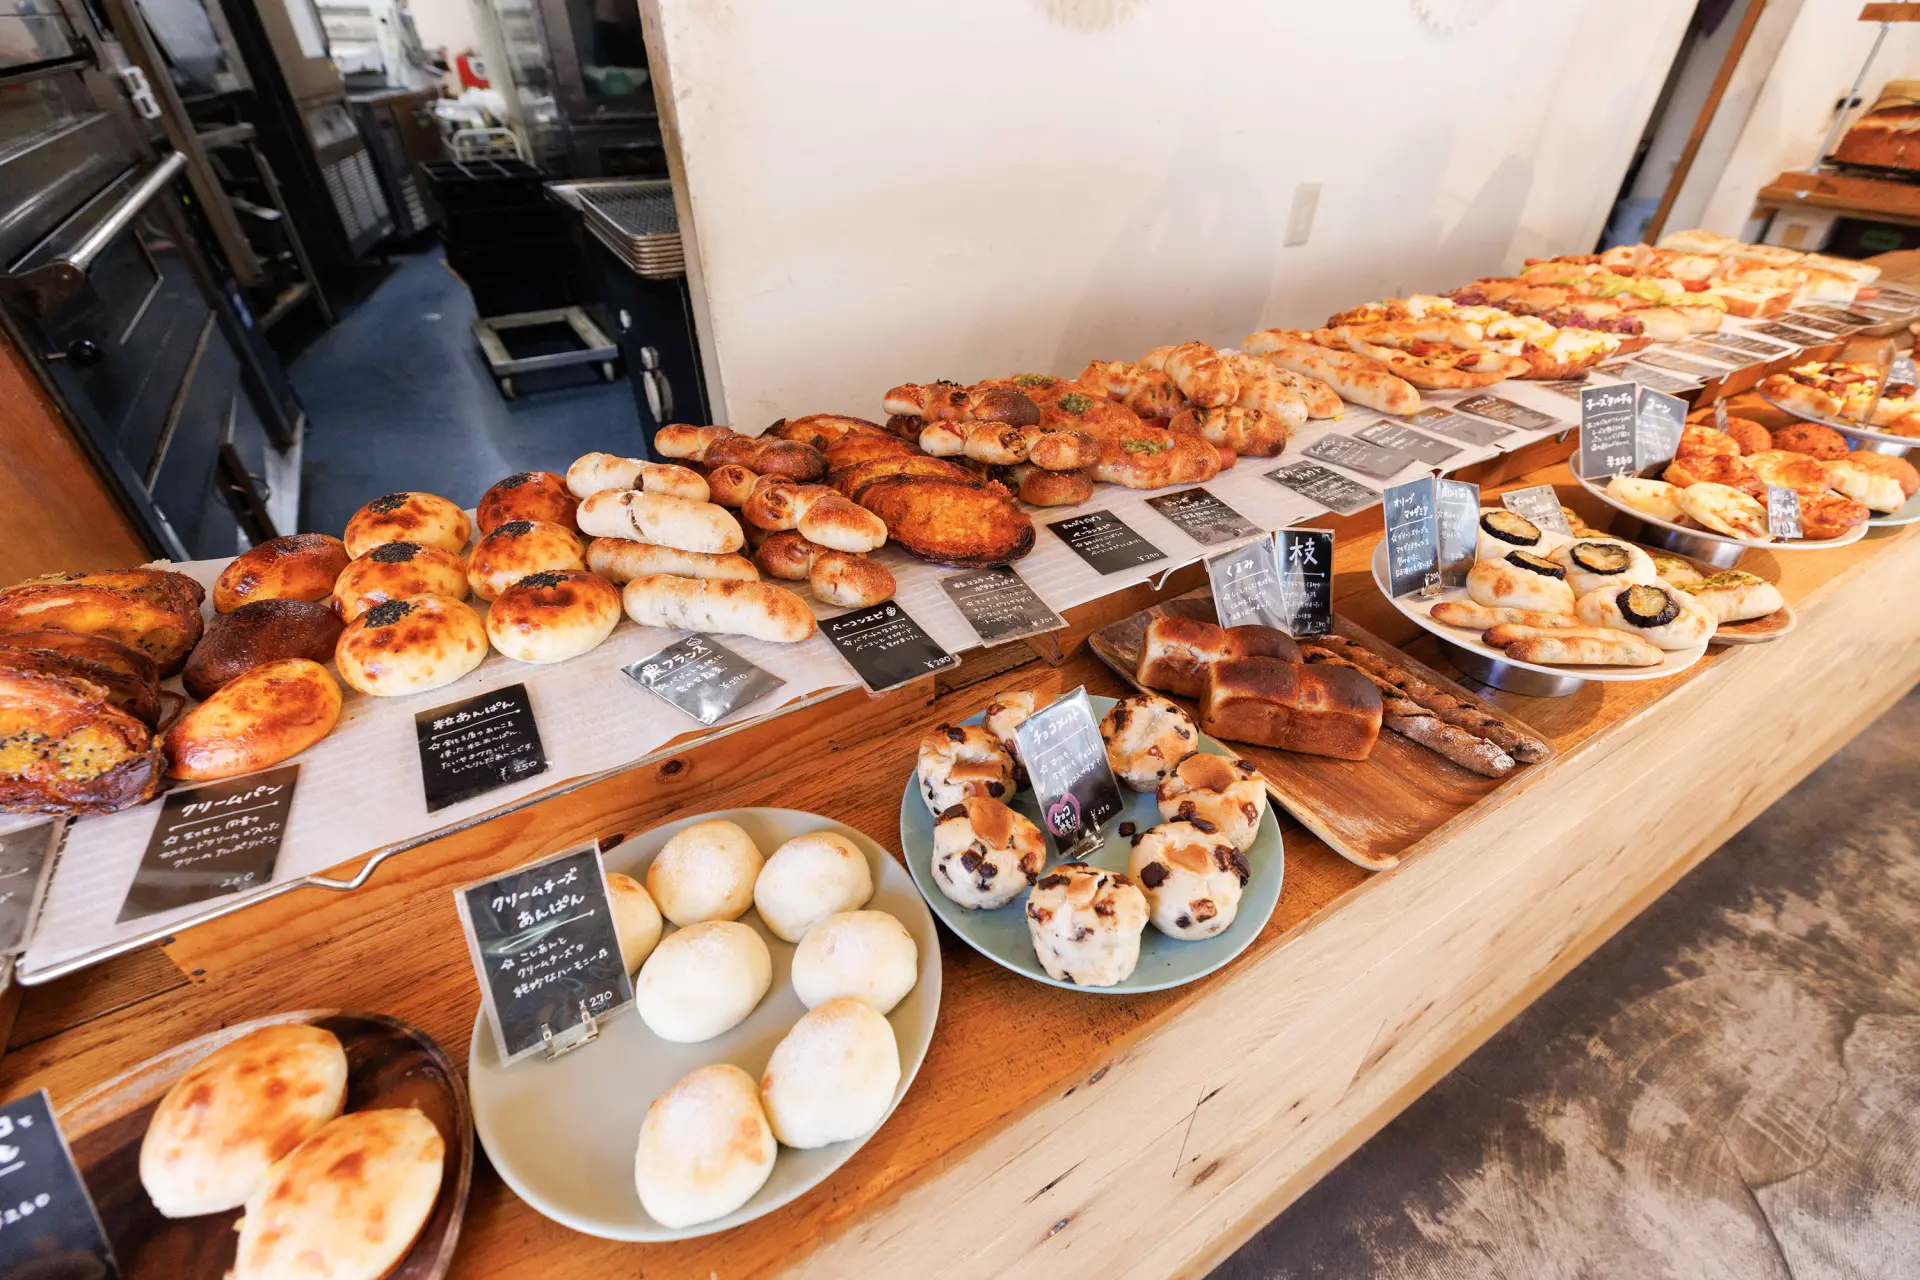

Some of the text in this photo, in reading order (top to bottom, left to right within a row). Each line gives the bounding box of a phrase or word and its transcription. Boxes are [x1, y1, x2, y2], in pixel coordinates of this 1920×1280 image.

[1646, 398, 1671, 413] コーン
[1297, 467, 1321, 480] クラウト
[1394, 492, 1416, 508] オリーブ
[1404, 506, 1429, 519] マカダミア
[1073, 523, 1111, 538] ベーコンエピ
[1289, 536, 1318, 566] 枝
[1226, 560, 1255, 577] くるみ
[832, 610, 883, 632] ベーコンエピ
[642, 645, 708, 679] 栗フランス
[923, 655, 951, 669] ¥280
[433, 701, 515, 731] 粒あんぱん
[1033, 708, 1080, 745] チョコメルト
[499, 760, 538, 781] ¥250
[181, 784, 284, 818] クリームパン
[1054, 805, 1072, 826] チョコ
[491, 866, 578, 913] クリームチーズ
[517, 894, 585, 929] あんぱん
[517, 943, 584, 979] クリームチーズの
[520, 937, 567, 963] こしあんと
[512, 955, 597, 999] 絶妙なハーモニー
[0, 1192, 51, 1230] 260
